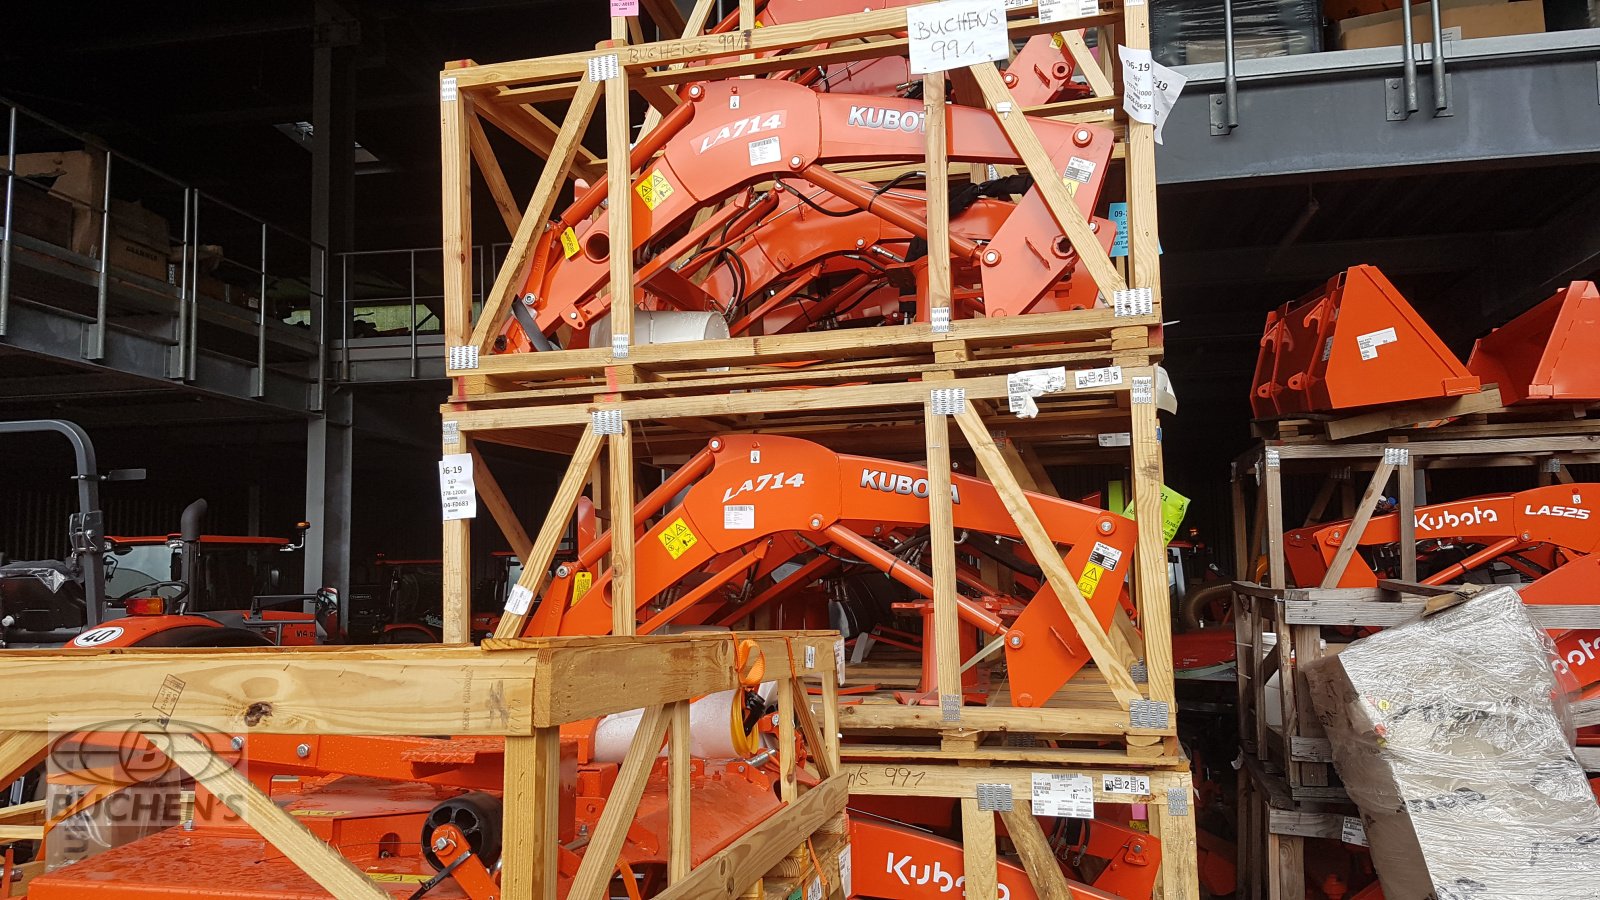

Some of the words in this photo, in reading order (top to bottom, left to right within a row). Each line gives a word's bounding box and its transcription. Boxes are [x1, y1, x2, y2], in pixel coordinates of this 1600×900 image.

[914, 8, 999, 41] BUCHENS
[1125, 59, 1151, 72] 06-19
[848, 105, 926, 133] KUBOT
[699, 113, 783, 155] LA714
[1097, 374, 1103, 382] 2
[1113, 371, 1119, 380] 5
[722, 472, 805, 503] LA714
[860, 468, 961, 504] KUBOA
[1414, 505, 1498, 531] Kubota
[1525, 504, 1591, 521] LA525
[82, 629, 116, 643] 40
[1124, 780, 1130, 790] 2
[1139, 782, 1145, 790] 5
